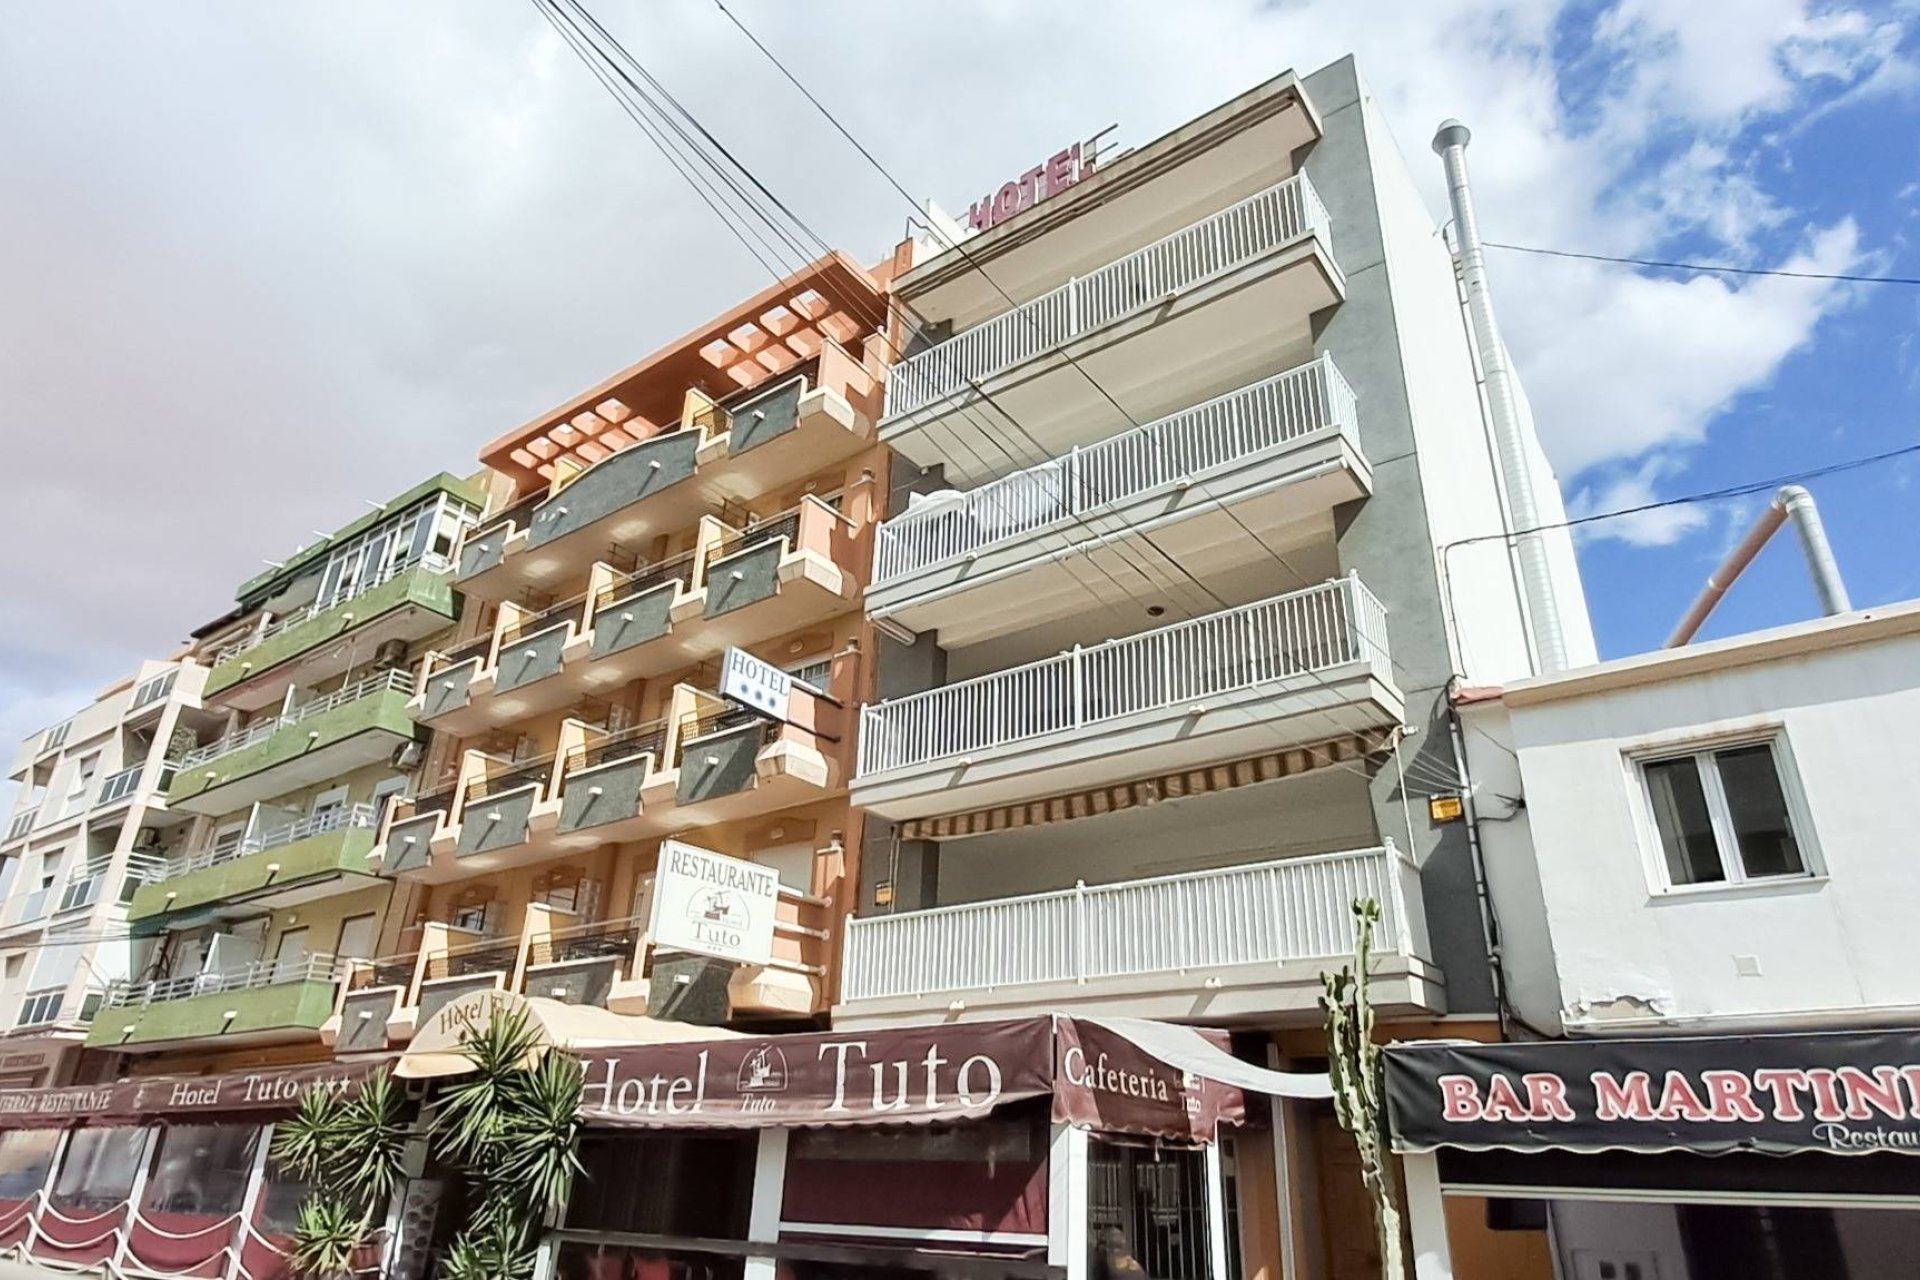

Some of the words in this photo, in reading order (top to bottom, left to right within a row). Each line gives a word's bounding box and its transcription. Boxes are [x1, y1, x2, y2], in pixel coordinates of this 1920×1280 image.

[968, 141, 1097, 233] HOTEL
[731, 652, 788, 697] HOTEL
[670, 850, 774, 898] RESTAURANTE
[691, 920, 742, 947] Tuto
[439, 995, 485, 1035] Hotel
[168, 1080, 223, 1107] Hotel
[243, 1074, 299, 1103] Tuto
[575, 1050, 710, 1116] Hotel
[818, 1041, 1003, 1113] Tuto
[1064, 1047, 1170, 1103] Cafeteria
[1436, 1072, 1577, 1122] BAR
[738, 1092, 777, 1113] Tuto
